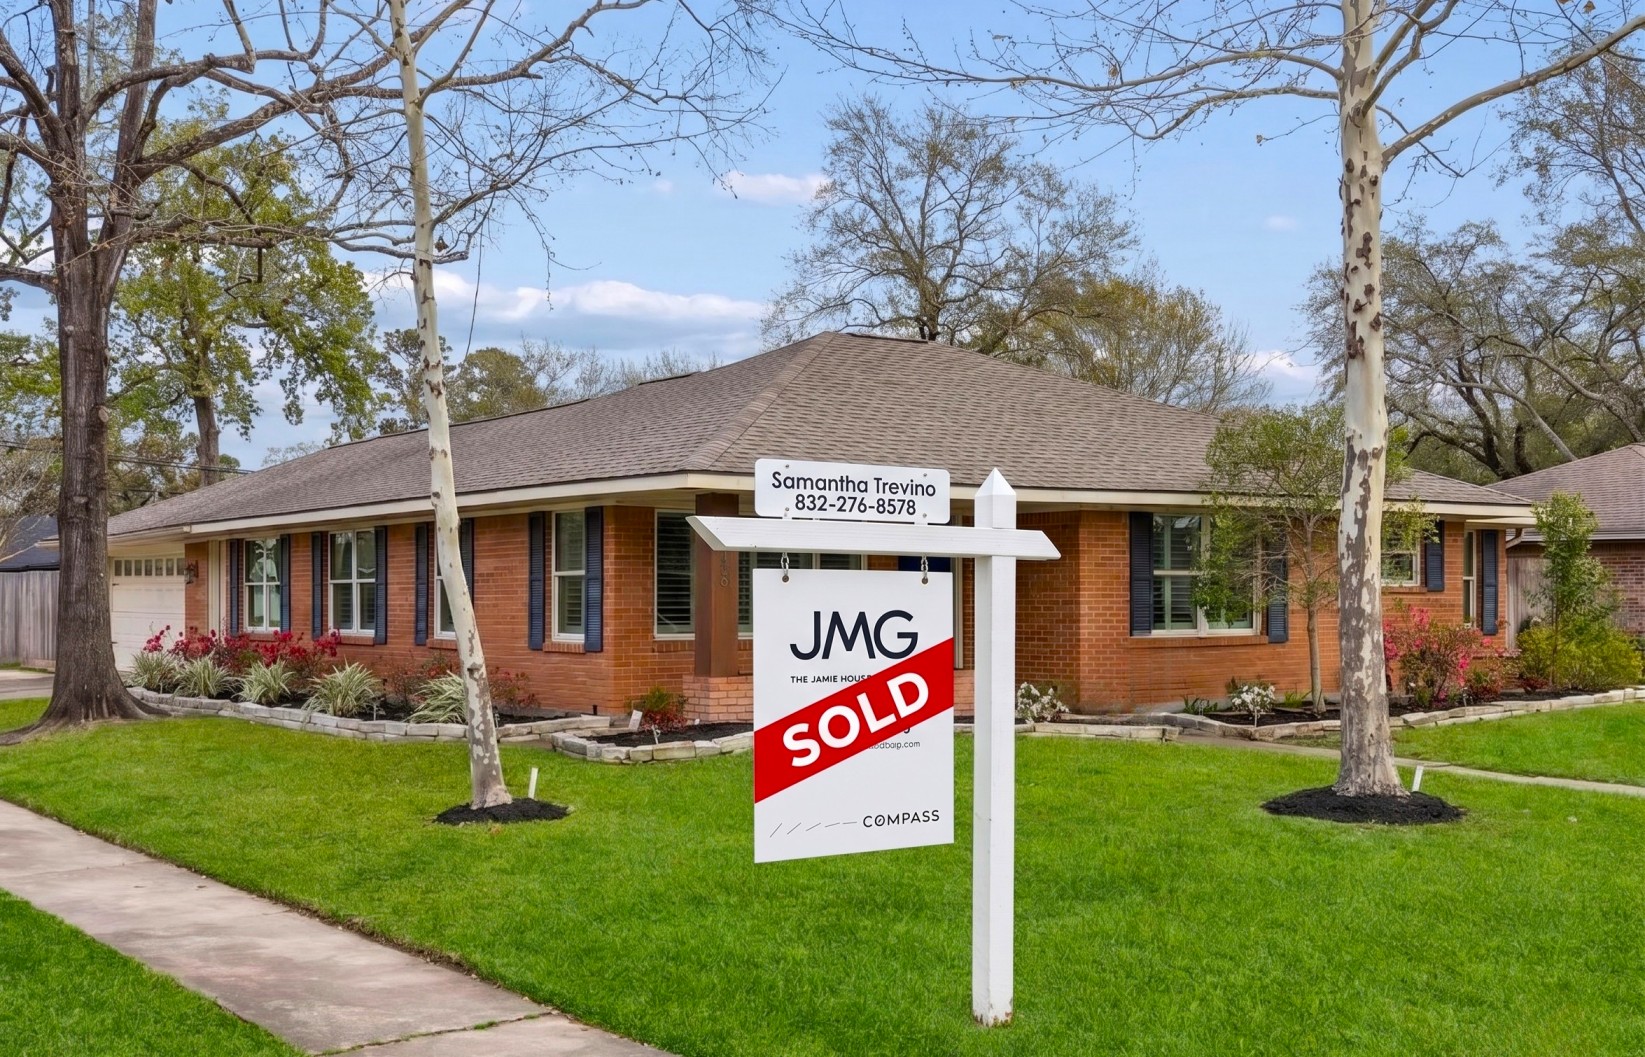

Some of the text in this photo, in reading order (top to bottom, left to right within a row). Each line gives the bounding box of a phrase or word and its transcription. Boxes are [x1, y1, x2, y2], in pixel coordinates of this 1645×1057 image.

[771, 471, 936, 497] Samantha Trevino
[795, 494, 916, 515] 832-276-8578
[789, 609, 918, 660] JMG
[790, 675, 808, 683] THE
[811, 675, 838, 683] JAMIE
[782, 672, 929, 767] SOLD
[863, 809, 939, 828] COMPASS
